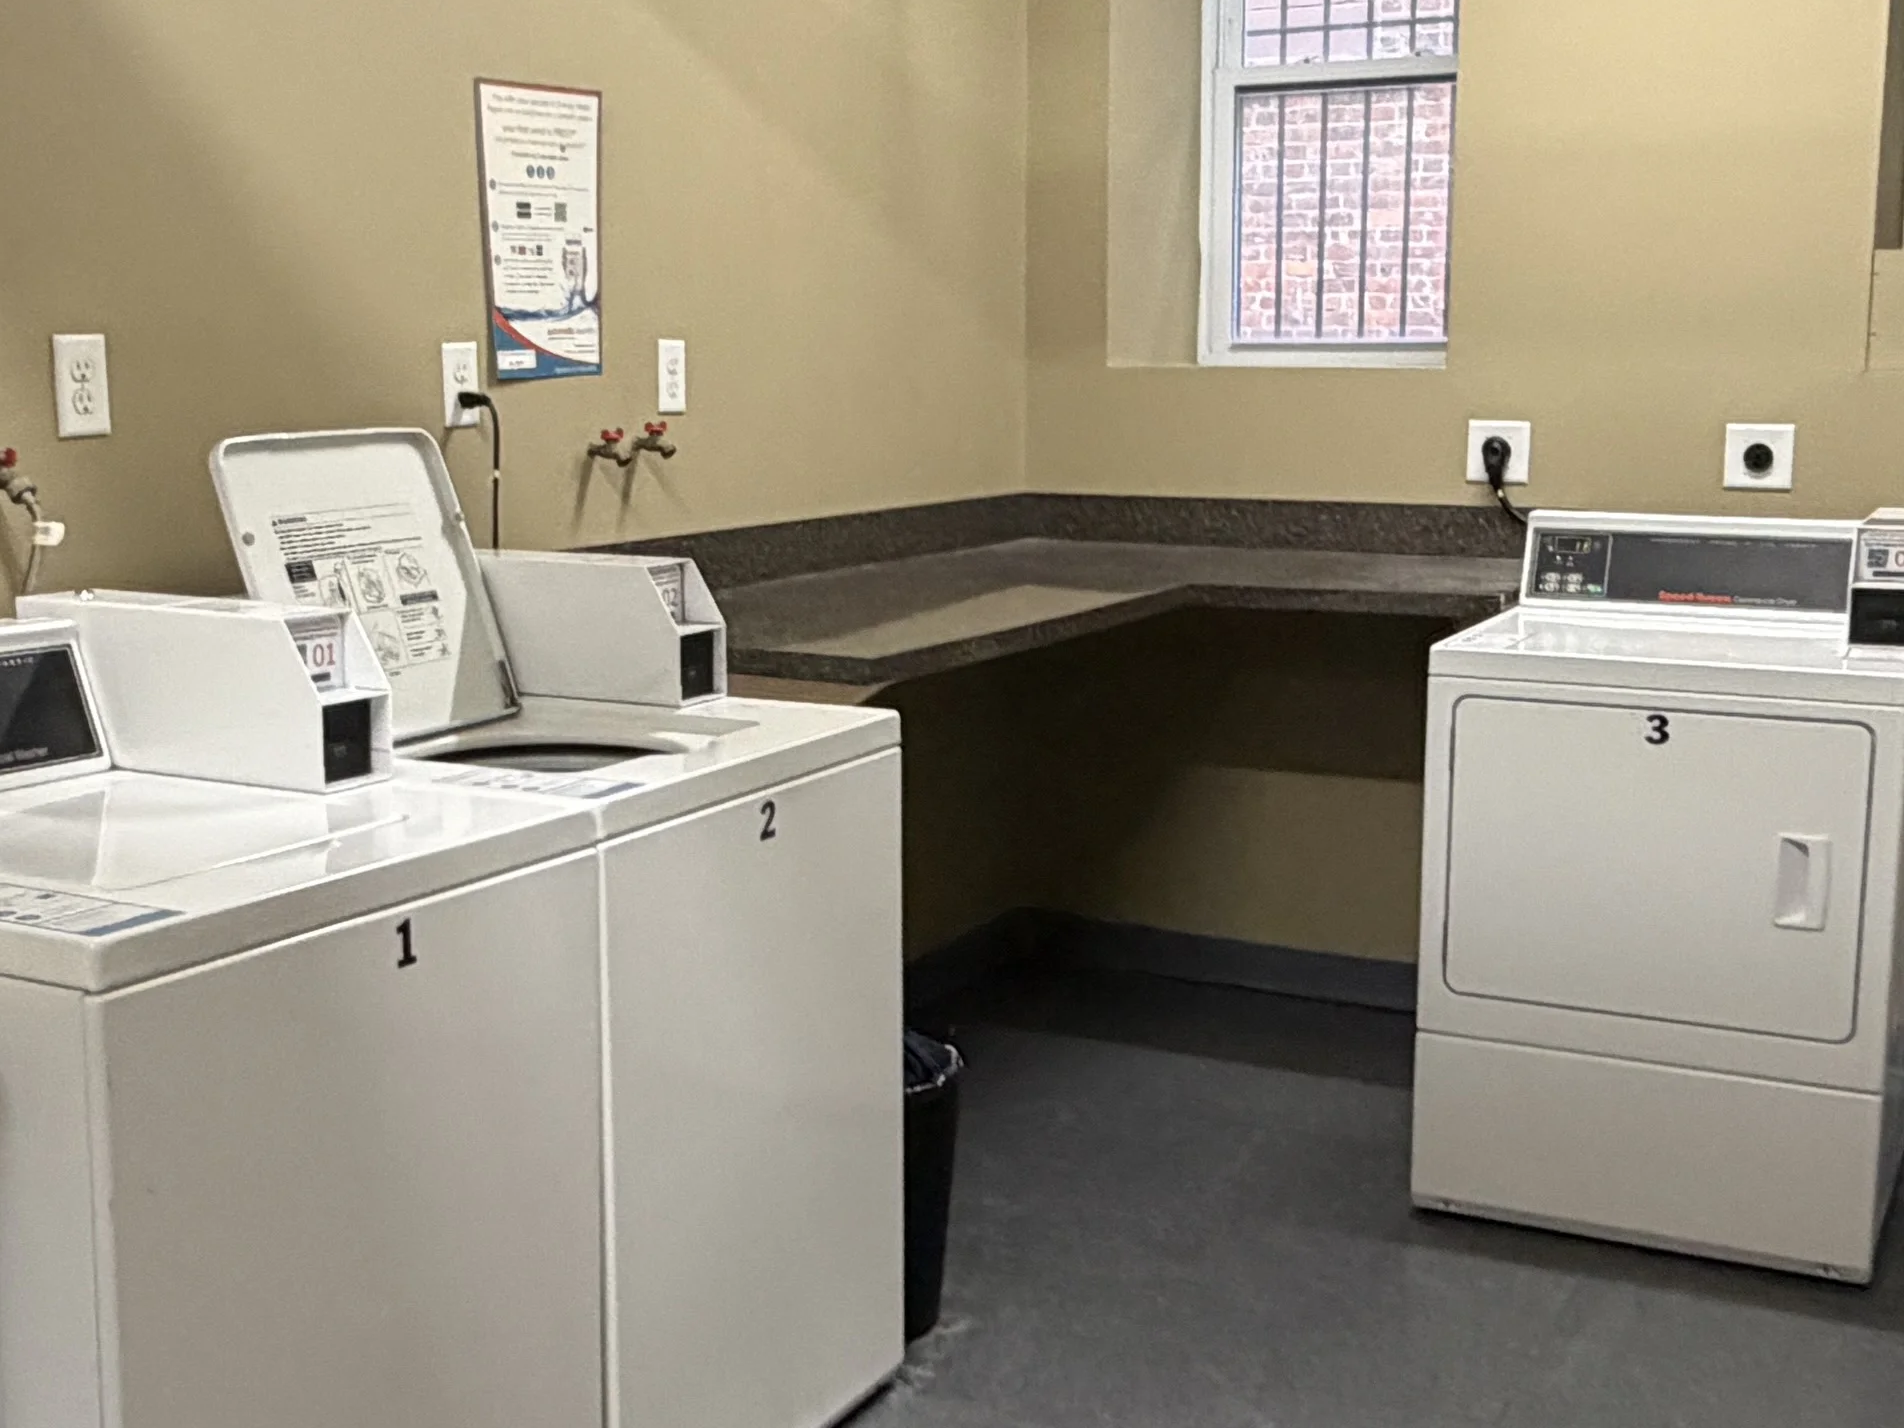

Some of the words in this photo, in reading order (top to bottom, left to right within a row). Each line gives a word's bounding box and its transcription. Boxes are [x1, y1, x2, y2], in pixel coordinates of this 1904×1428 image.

[312, 642, 336, 667] 01
[1645, 714, 1670, 745] 3
[760, 800, 776, 842] 2
[396, 917, 418, 968] 1
